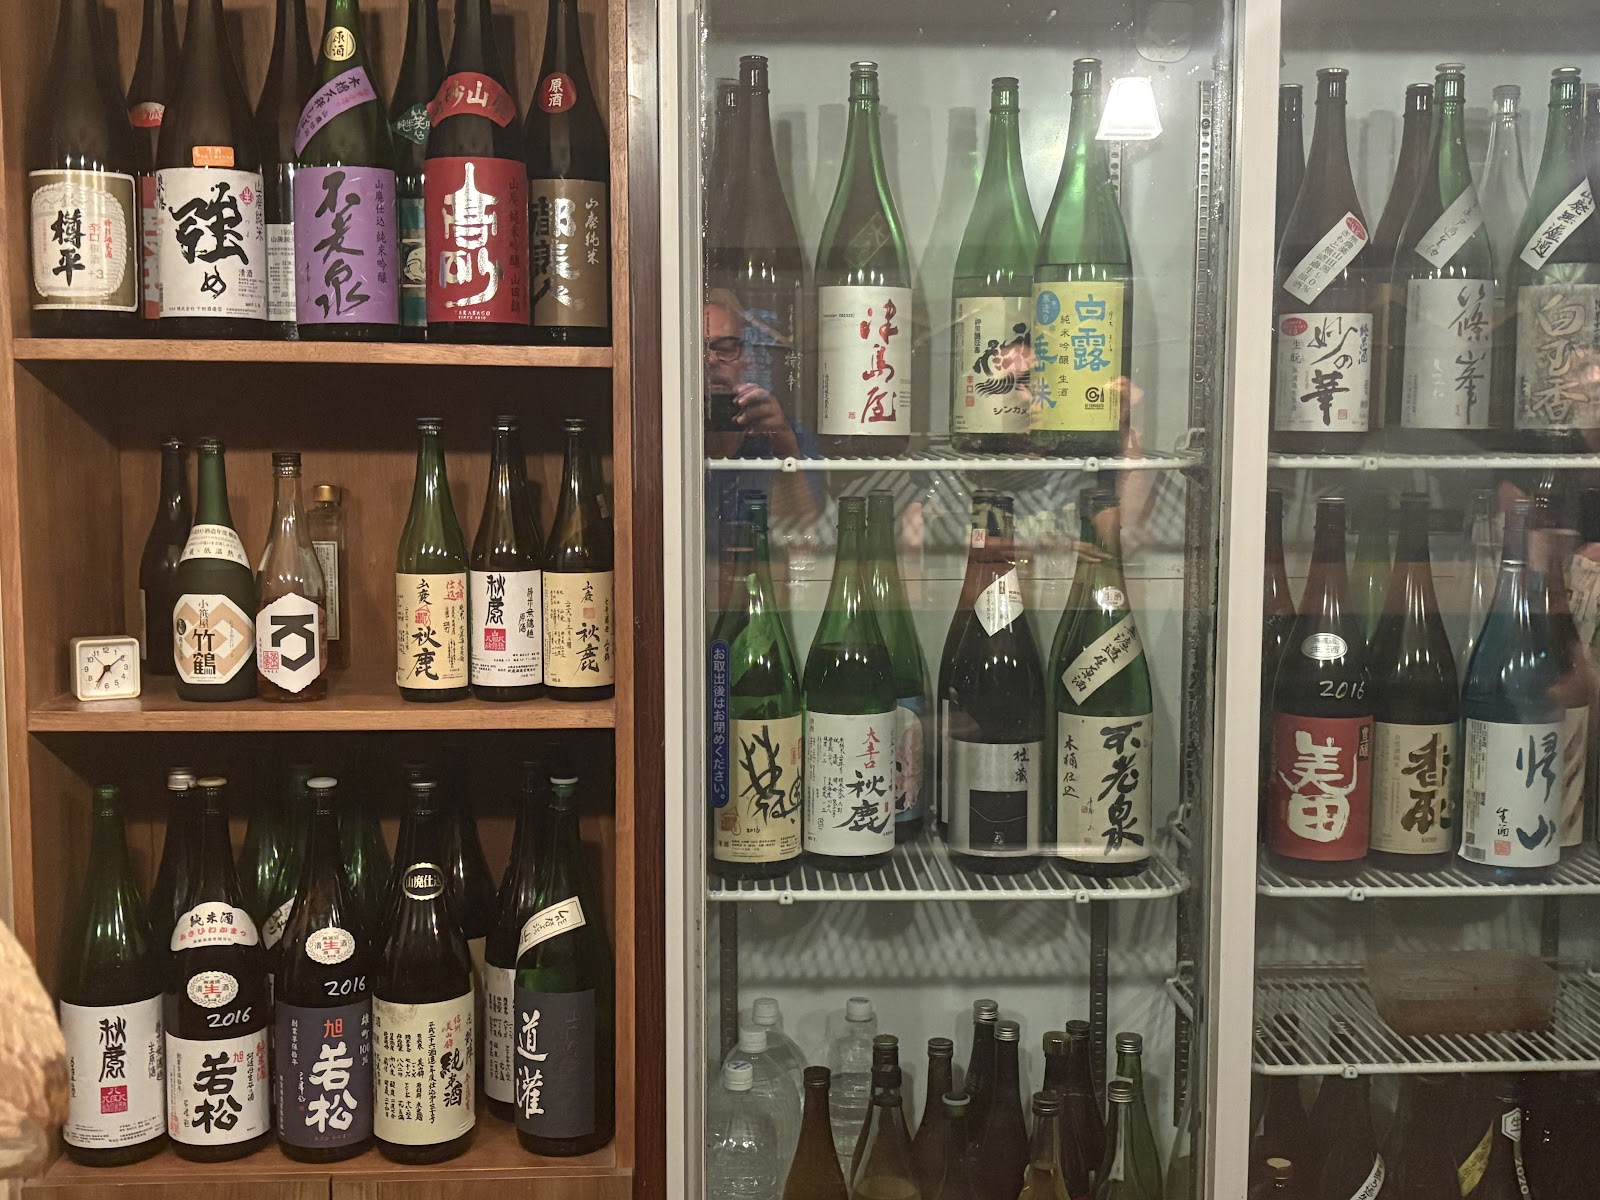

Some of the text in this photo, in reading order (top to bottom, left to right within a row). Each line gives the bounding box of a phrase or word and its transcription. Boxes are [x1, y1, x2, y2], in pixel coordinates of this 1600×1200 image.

[333, 31, 345, 57] 原酒
[547, 77, 563, 108] 原酒
[51, 208, 86, 287] 樽平
[314, 170, 369, 317] 不老泉
[585, 197, 600, 265] 山廃純米
[376, 233, 388, 284] 純米吟醸
[1057, 314, 1071, 398] 純米吟醸 生酒
[1070, 293, 1111, 372] 白露
[966, 375, 975, 394] 辛口
[1299, 315, 1358, 427] 妙の華
[993, 404, 1028, 416] シンカメ
[192, 628, 217, 676] 竹鶴
[408, 628, 444, 681] 秋鹿
[574, 622, 601, 676] 秋鹿
[1319, 680, 1365, 700] 2016
[712, 647, 726, 801] お取出後はお閉めください。
[857, 726, 881, 770] 大辛口
[1062, 734, 1080, 799] 木桶仕込
[1098, 723, 1144, 857] 不老泉
[1276, 730, 1357, 843] 美田
[831, 770, 892, 834] 秋鹿
[405, 875, 442, 889] 山廃仕込
[180, 927, 247, 941] あさひわかまつ
[189, 912, 234, 928] 純米酒
[322, 940, 341, 951] 生
[203, 984, 222, 995] 生
[324, 976, 366, 997] 2016
[207, 1006, 252, 1028] 2016
[323, 1019, 344, 1041] 旭
[233, 1050, 244, 1064] 旭
[439, 1047, 464, 1109] 純米酒
[516, 1011, 550, 1123] 道灌
[191, 1051, 243, 1134] 若松
[304, 1041, 358, 1134] 若松
